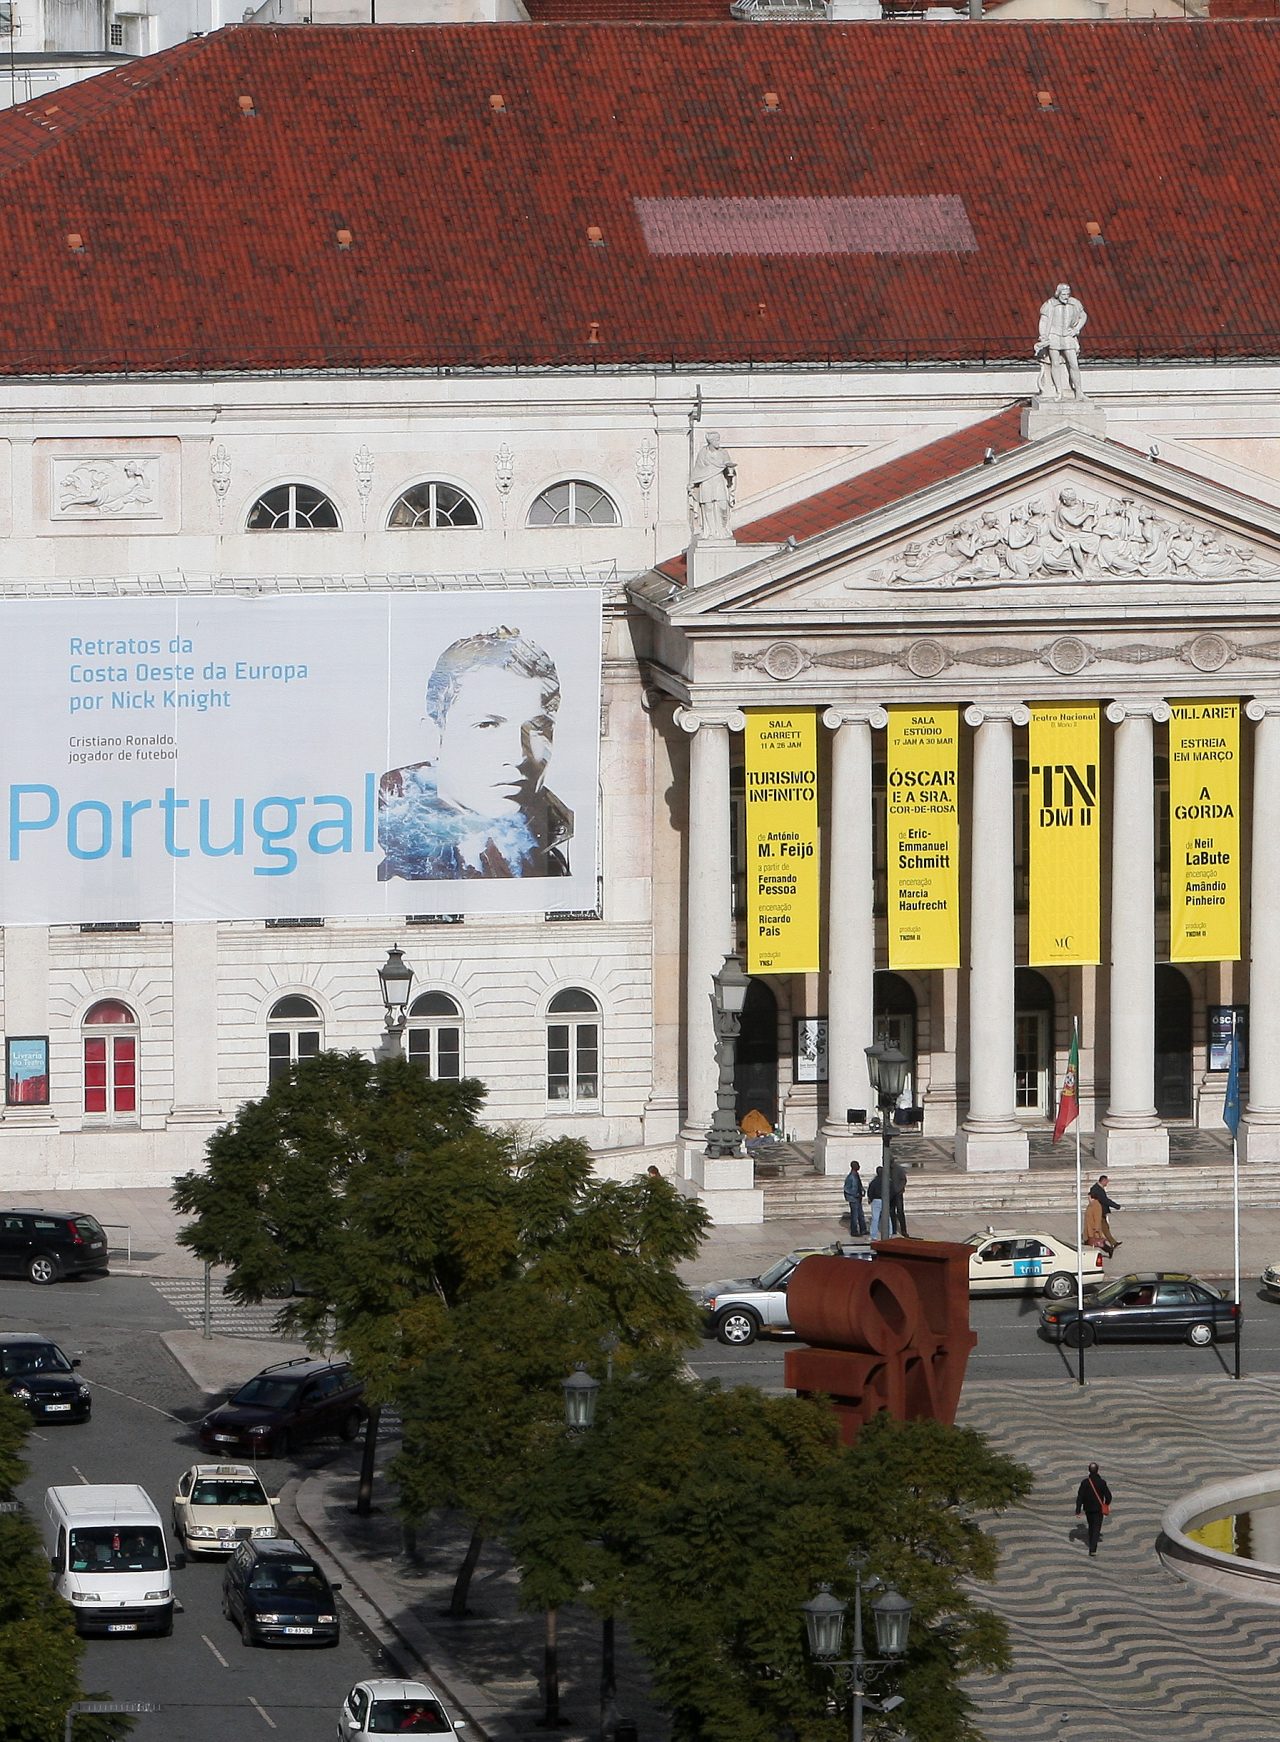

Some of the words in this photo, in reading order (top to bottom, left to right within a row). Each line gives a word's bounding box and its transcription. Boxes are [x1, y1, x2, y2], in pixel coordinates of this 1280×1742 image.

[70, 638, 161, 655] Retratos
[169, 636, 193, 653] da
[70, 665, 127, 683] Costa
[136, 664, 194, 681] Oeste
[203, 662, 227, 680] da
[235, 662, 308, 683] Europa
[70, 695, 103, 714] por
[112, 691, 155, 709] Nick
[163, 689, 231, 711] Knight
[1032, 714, 1057, 722] Teatro
[1060, 713, 1096, 721] Nacional
[1171, 707, 1237, 719] VILLARET
[912, 717, 935, 725] SALA
[760, 731, 801, 739] GARRETT
[904, 726, 942, 736] ESTÚDIO
[69, 736, 122, 747] Cristiano
[1181, 738, 1226, 748] ESTREIA
[68, 751, 113, 764] jogador
[118, 750, 132, 761] de
[136, 749, 178, 760] futebol
[1174, 752, 1189, 761] EM
[1193, 751, 1233, 762] MARÇO
[747, 771, 815, 785] TURISMO
[890, 768, 955, 787] ÓSCAR
[1032, 765, 1096, 807] TN
[750, 788, 814, 802] INFINITO
[893, 792, 901, 802] E
[906, 791, 915, 802] A
[920, 790, 952, 802] SRA.
[1199, 786, 1211, 801] A
[890, 805, 955, 814] COR-DE-ROSA
[1175, 804, 1234, 820] GORDA
[1040, 808, 1073, 827] DM
[1081, 808, 1091, 826] II
[9, 773, 375, 875] Portugal
[768, 832, 799, 840] António
[899, 831, 906, 839] de
[908, 829, 931, 838] Eric-
[899, 841, 948, 852] Emmanuel
[1186, 842, 1193, 850] de
[1195, 838, 1213, 848] Neil
[759, 844, 775, 857] M.
[781, 842, 813, 859] Feijó
[899, 855, 950, 869] Schmitt
[1186, 852, 1230, 865] LaBute
[764, 863, 780, 872] partir
[759, 874, 797, 883] Fernando
[1186, 869, 1217, 879] encenação
[899, 878, 932, 887] encenação
[1186, 881, 1226, 892] Amândio
[759, 884, 796, 895] Pessoa
[900, 889, 928, 898] Marcia
[1186, 895, 1225, 905] Pinheiro
[759, 903, 791, 912] encenação
[899, 901, 947, 911] Haufrecht
[759, 915, 790, 923] Ricardo
[759, 926, 781, 936] Pais
